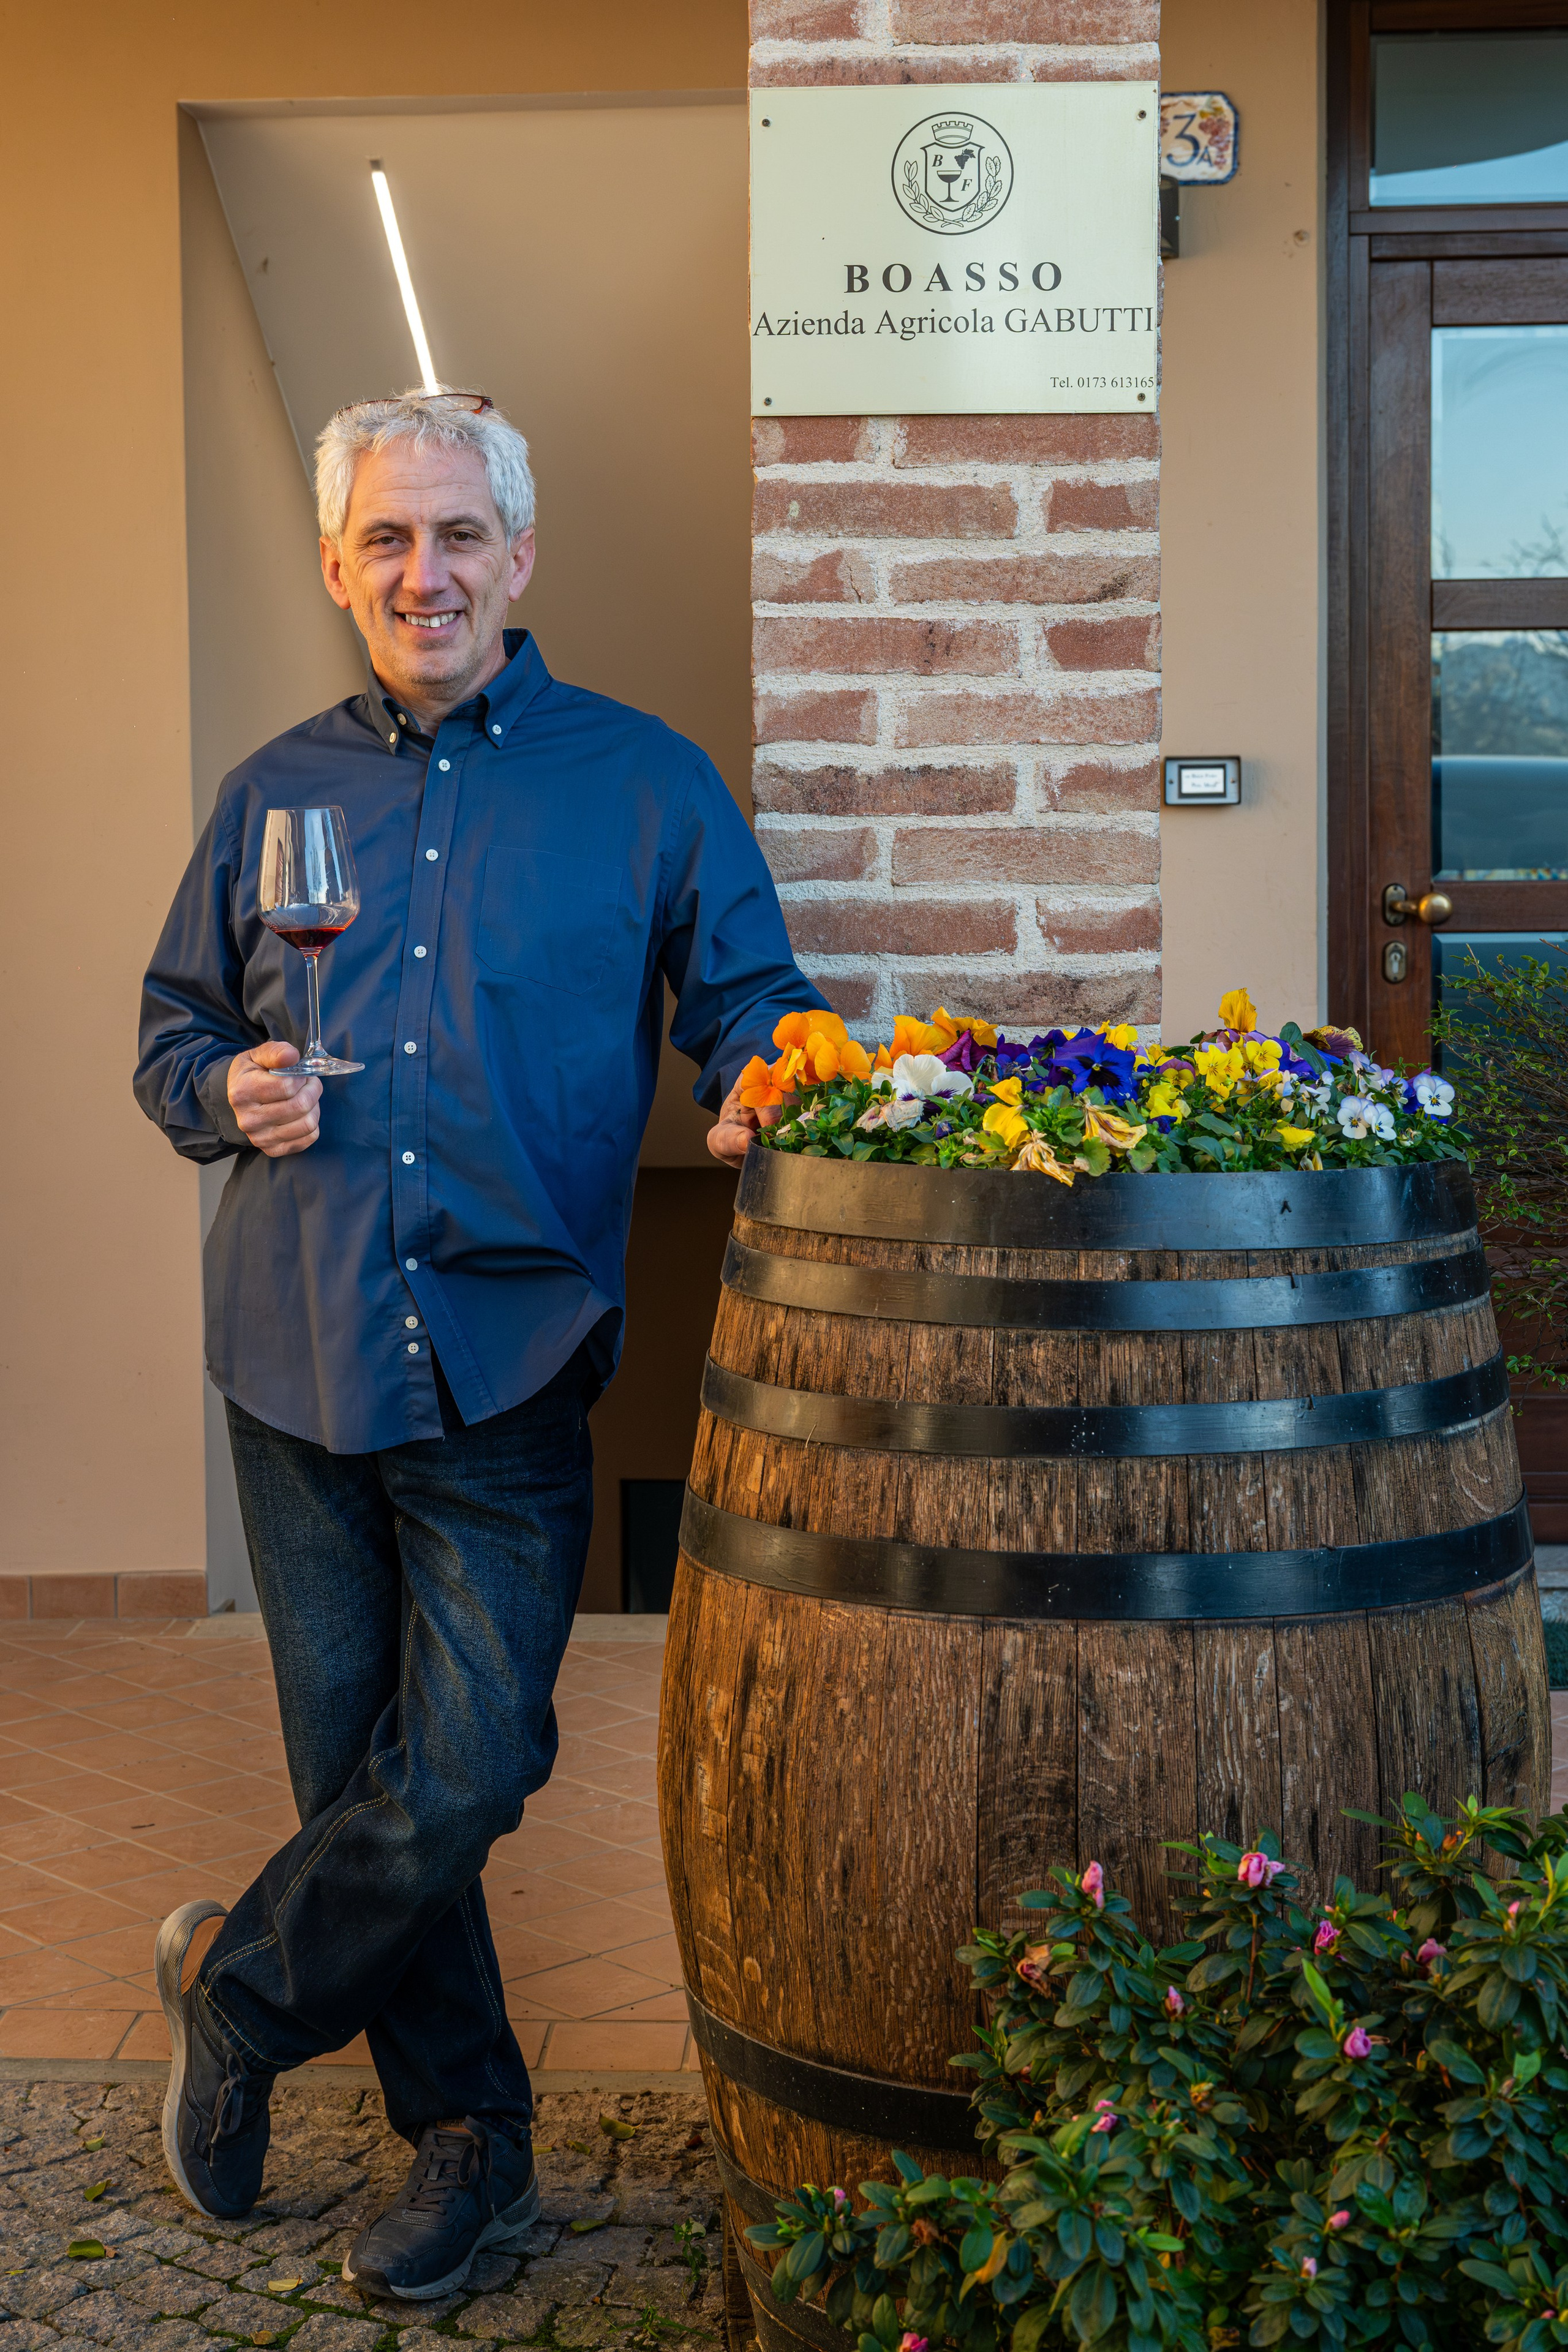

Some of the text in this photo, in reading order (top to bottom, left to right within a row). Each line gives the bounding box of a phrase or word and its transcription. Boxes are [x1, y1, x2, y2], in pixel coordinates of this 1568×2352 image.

[931, 154, 943, 167] B
[960, 178, 973, 192] F
[843, 262, 1062, 293] BOASSO
[752, 307, 1154, 341] Azienda Agricola GABUTTI
[1050, 377, 1154, 388] Tel. 0173 613165
